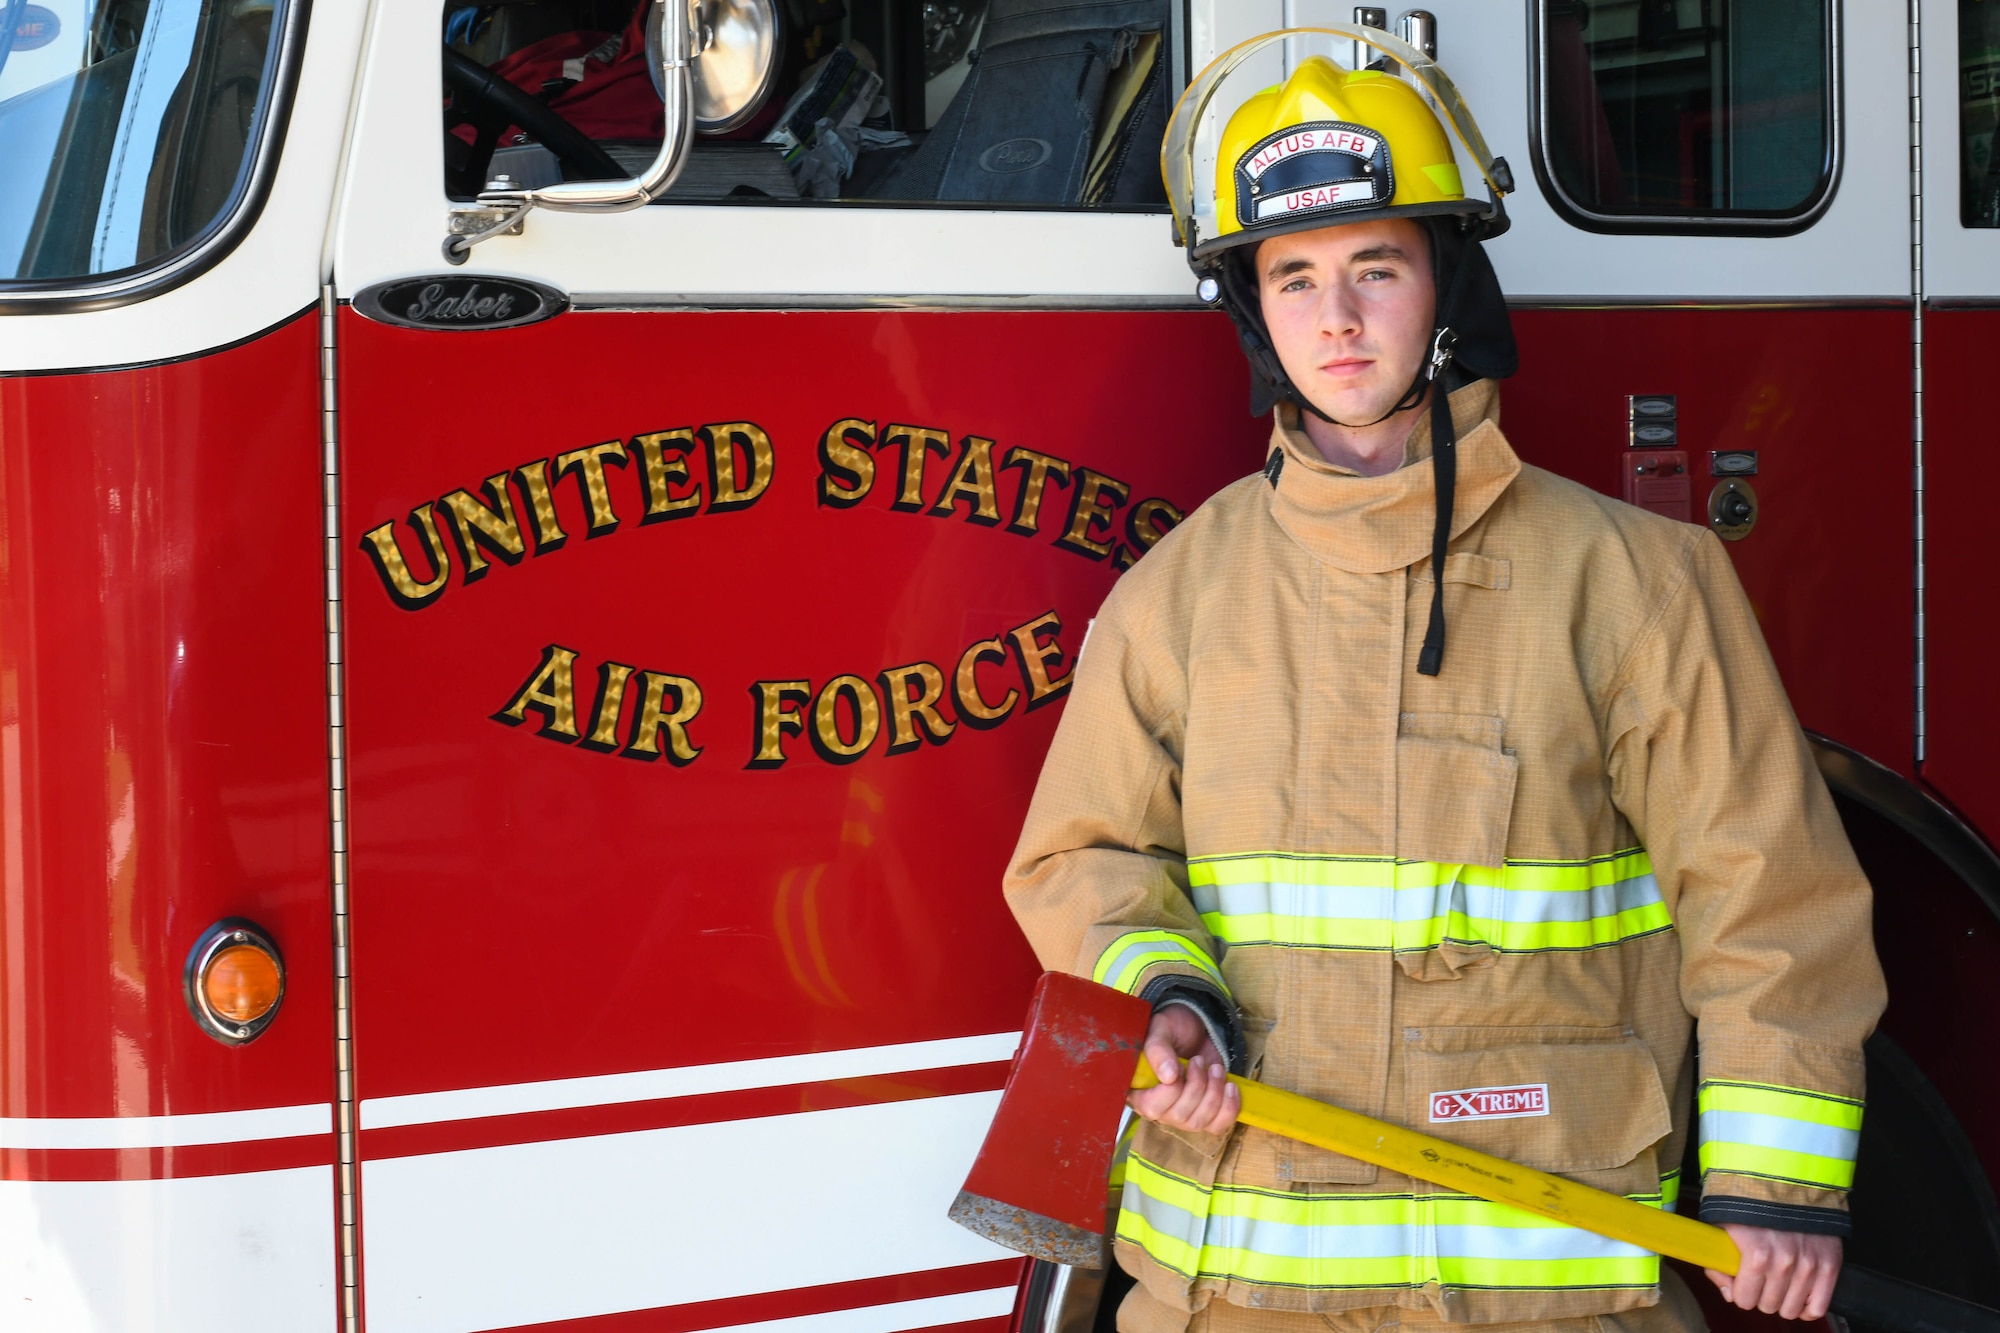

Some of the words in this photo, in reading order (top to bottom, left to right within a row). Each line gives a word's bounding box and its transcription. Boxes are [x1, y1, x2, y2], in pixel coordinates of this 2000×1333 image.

[1253, 132, 1315, 174] ALTUS
[1321, 132, 1366, 153] AFB
[1286, 187, 1341, 210] USAF
[406, 283, 516, 321] Saber
[360, 420, 775, 612] UNITED
[817, 417, 1184, 571] STATES
[489, 644, 704, 767] AIR
[744, 610, 1079, 769] FORCE
